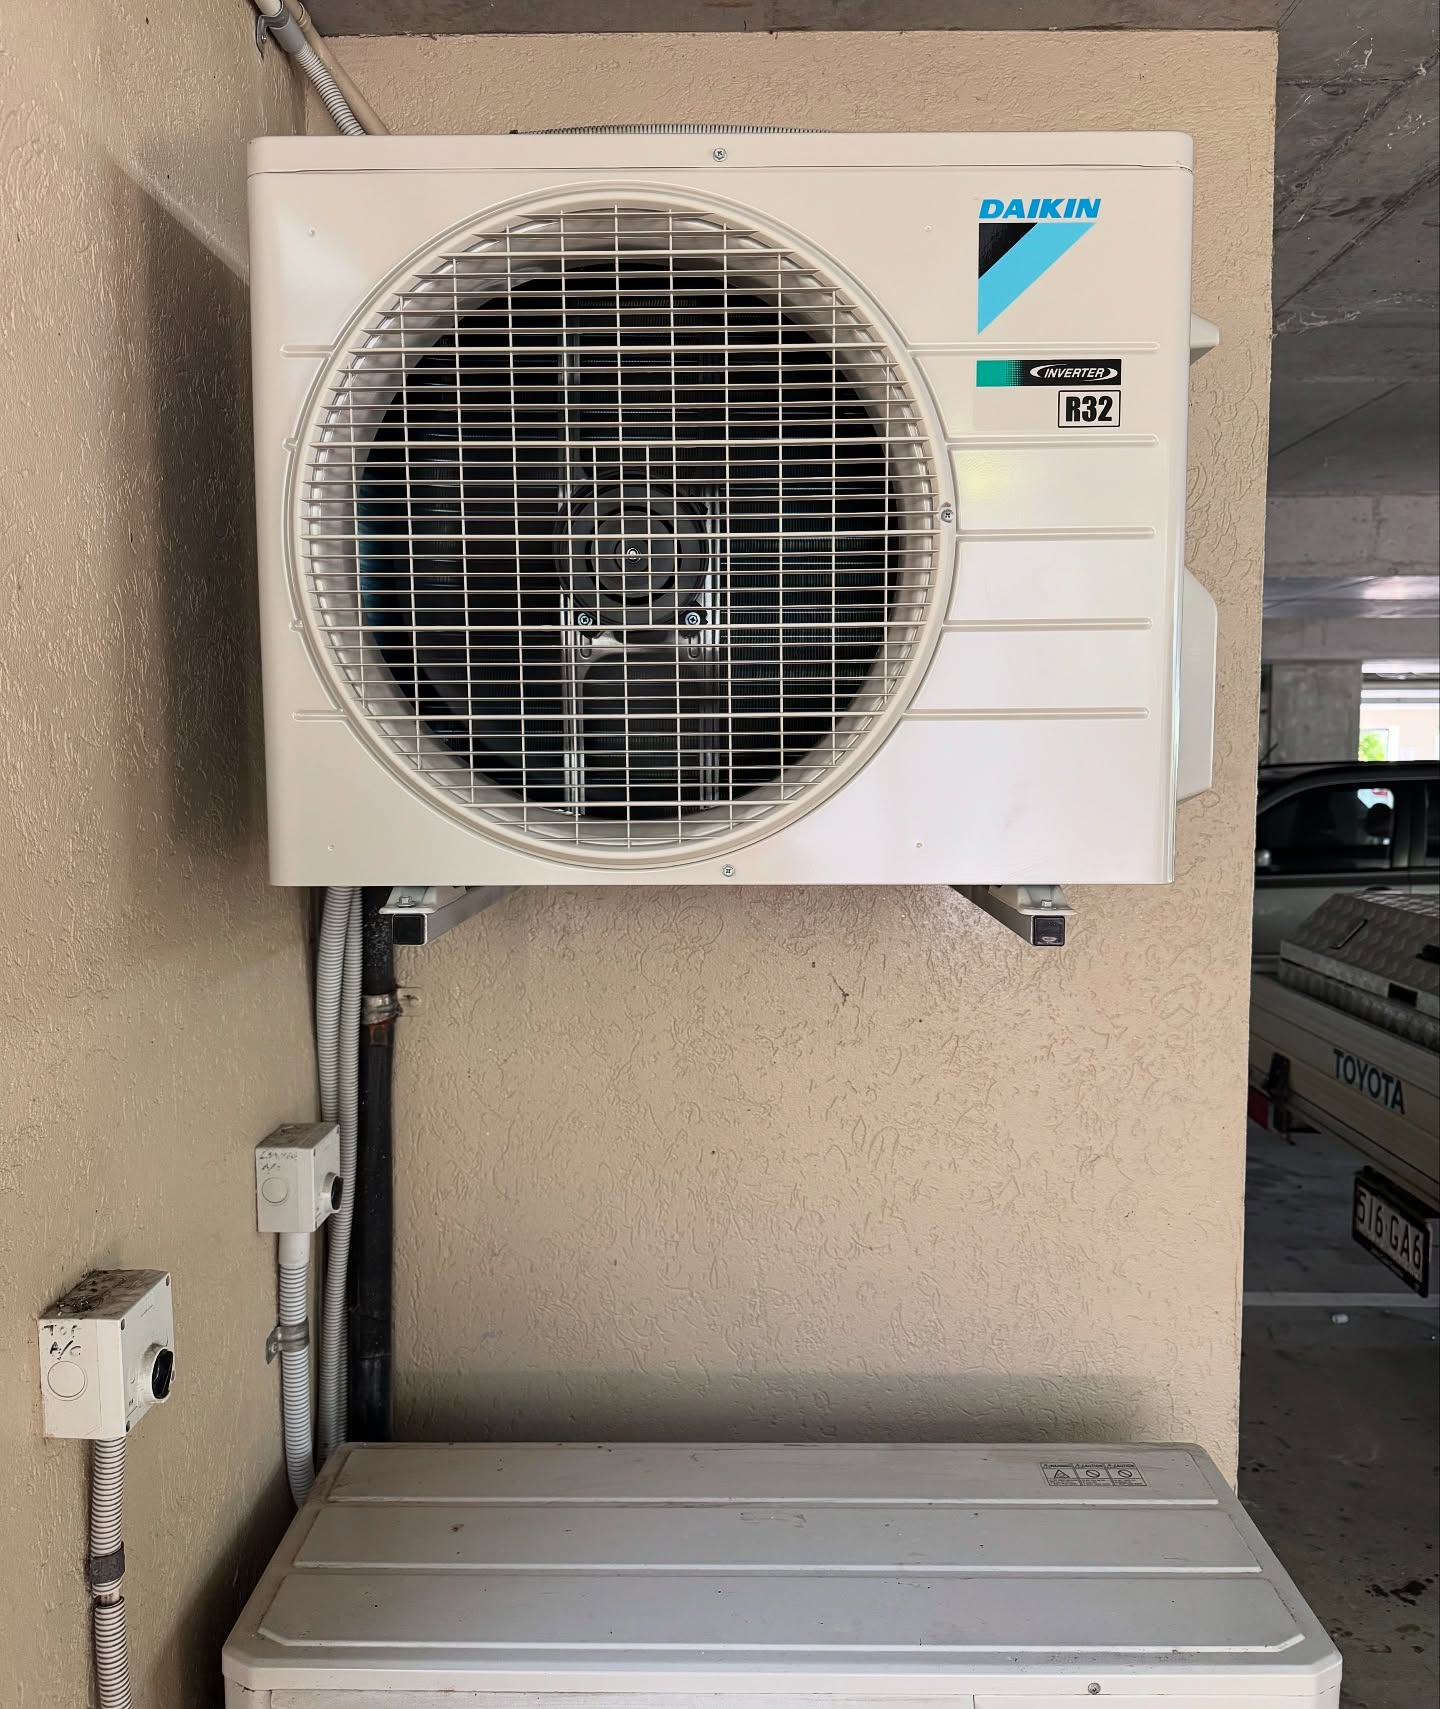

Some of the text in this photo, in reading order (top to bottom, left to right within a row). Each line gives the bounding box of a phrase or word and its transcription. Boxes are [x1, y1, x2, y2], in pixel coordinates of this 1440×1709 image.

[978, 198, 1101, 219] DAIKIN
[1044, 367, 1105, 379] INVERTER
[1065, 395, 1114, 422] R32
[1333, 1048, 1405, 1115] TOYOTA
